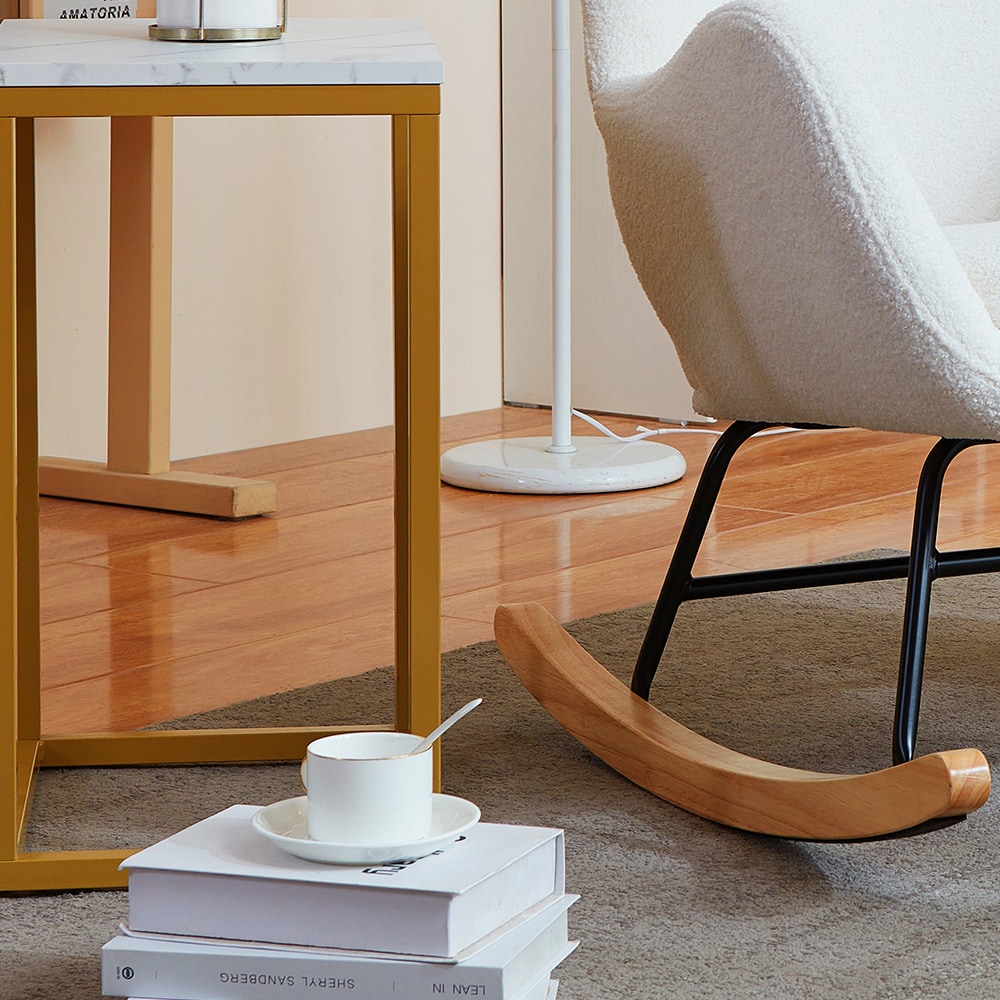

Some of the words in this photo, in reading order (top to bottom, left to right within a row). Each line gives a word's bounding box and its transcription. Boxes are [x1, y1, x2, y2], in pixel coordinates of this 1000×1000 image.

[59, 4, 131, 19] AMATORIA
[219, 972, 295, 987] SANDBERG
[302, 976, 355, 989] SHERYL
[432, 983, 445, 994] IN
[452, 983, 486, 996] LEAN
